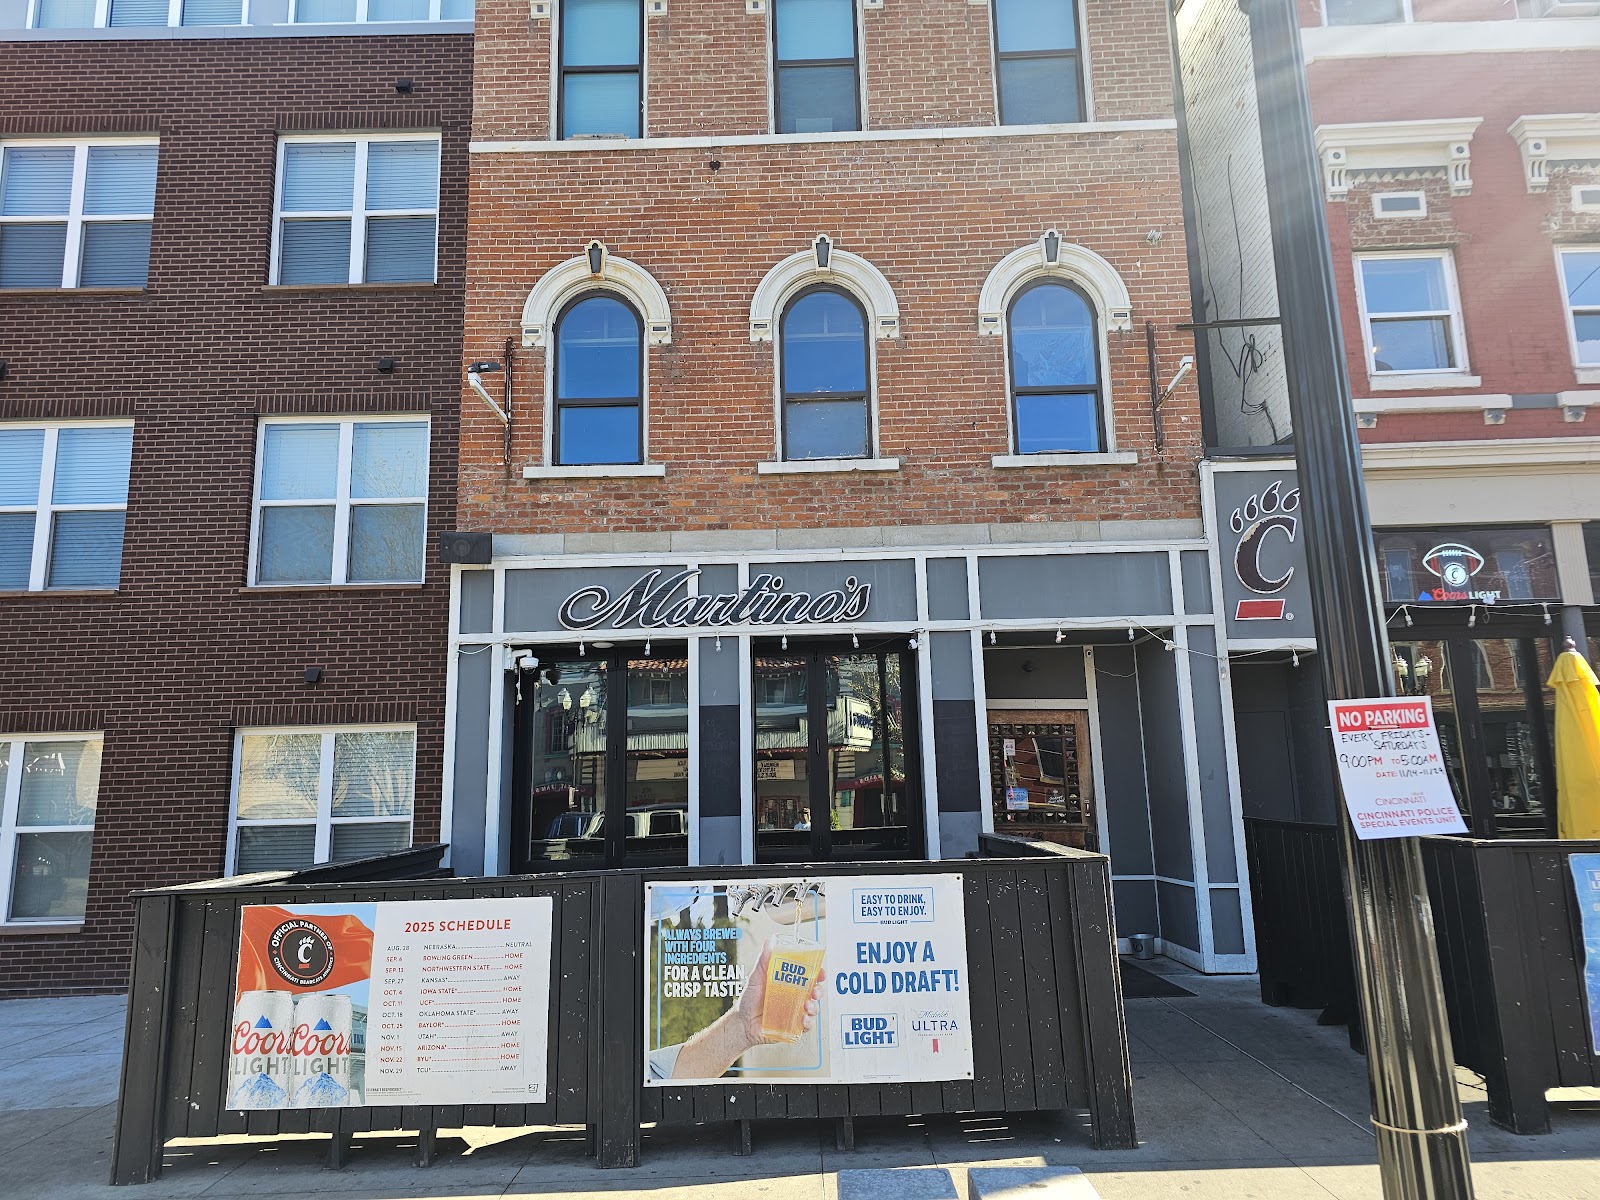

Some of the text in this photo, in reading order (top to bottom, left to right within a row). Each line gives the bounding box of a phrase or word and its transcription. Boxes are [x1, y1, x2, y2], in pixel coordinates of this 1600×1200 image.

[558, 568, 872, 630] Martino's
[1432, 588, 1501, 600] Coors LIGHT
[1338, 708, 1426, 727] NO PARKING
[1342, 732, 1374, 743] EVERY
[1375, 796, 1427, 806] CINCINNATI
[1357, 807, 1455, 821] CINCINNATI POLICE
[1360, 816, 1457, 829] SPECIAL EVENTS UNIT
[861, 894, 926, 905] EASY TO DRINK,
[862, 906, 927, 916] EASY TO ENJOY.
[404, 918, 512, 933] 2025 SCHEDULE
[272, 920, 333, 950] OFFICIAL PARTNER OF
[664, 928, 742, 940] ALWAYS BREWED
[664, 940, 716, 952] WITH FOUR
[856, 940, 936, 964] ENJOY A
[664, 952, 728, 964] INGREDIENTS
[274, 957, 300, 984] CINCINNATI
[664, 966, 688, 981] FOR
[690, 966, 700, 980] A
[781, 962, 806, 976] BUD
[774, 970, 809, 987] LIGHT
[836, 970, 960, 995] COLD DRAFT!
[664, 981, 743, 998] CRISP TASTE
[852, 1018, 888, 1030] BUD
[912, 1020, 959, 1031] ULTRA
[845, 1031, 895, 1045] LIGHT
[234, 1057, 289, 1076] LIGHT
[294, 1057, 349, 1076] LIGHT
